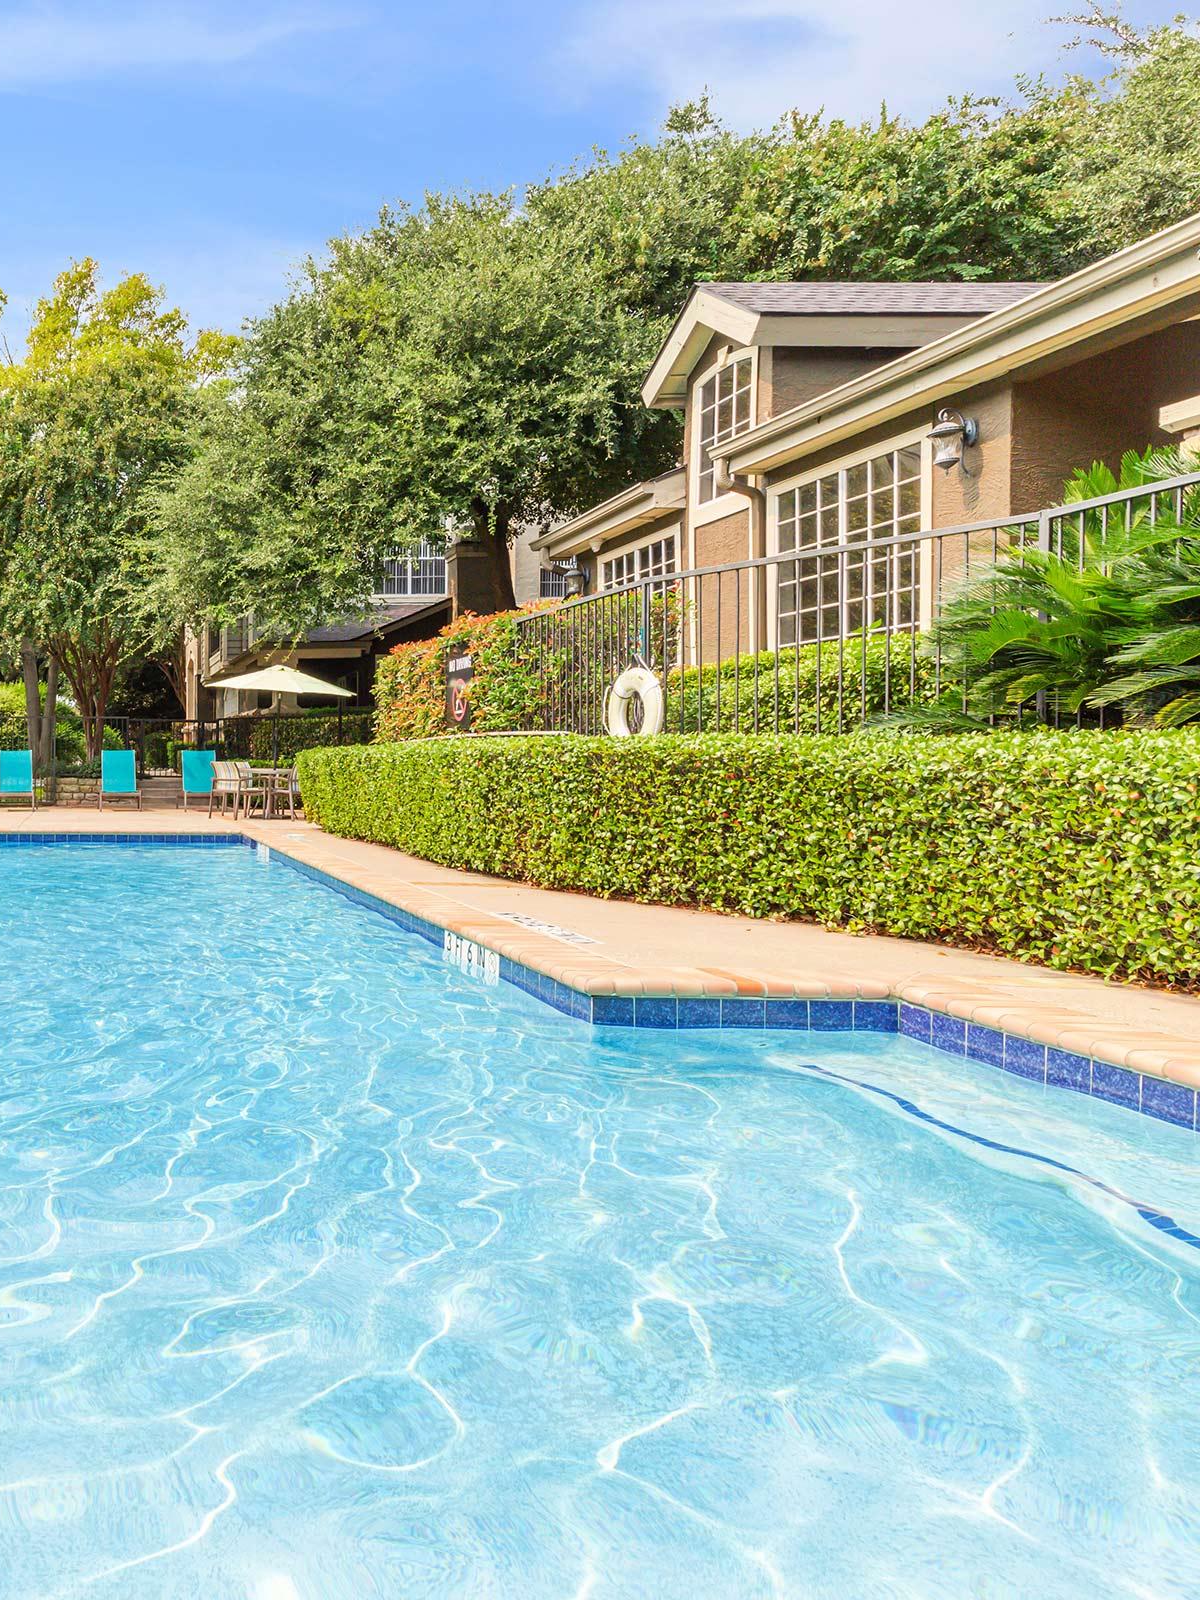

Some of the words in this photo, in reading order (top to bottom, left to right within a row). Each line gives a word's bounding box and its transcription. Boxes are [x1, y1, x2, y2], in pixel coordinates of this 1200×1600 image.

[446, 932, 451, 951] 3
[455, 936, 463, 958] FT
[467, 943, 472, 963] 6
[477, 945, 485, 968] IN
